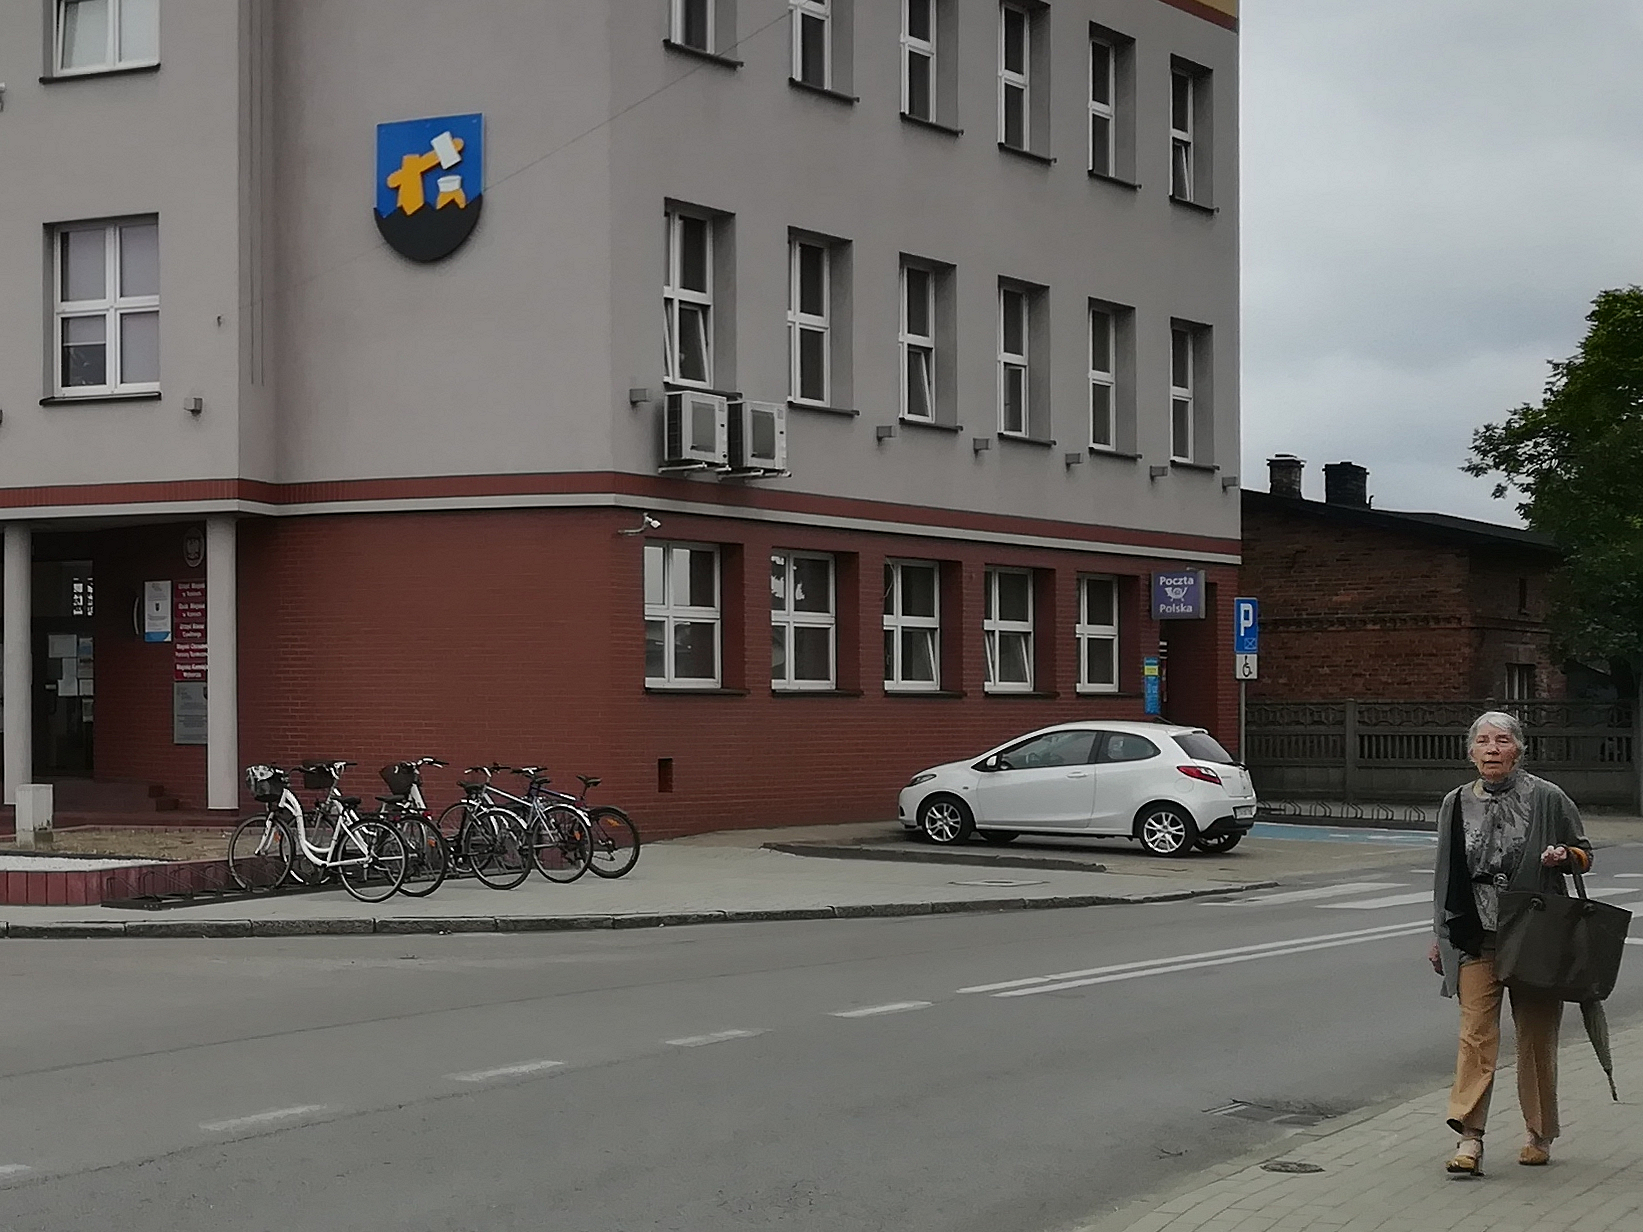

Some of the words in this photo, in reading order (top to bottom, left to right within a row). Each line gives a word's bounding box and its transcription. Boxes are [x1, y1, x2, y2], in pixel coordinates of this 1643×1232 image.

[1159, 576, 1194, 586] Poczta
[1159, 603, 1193, 613] Polska
[1240, 603, 1253, 636] P
